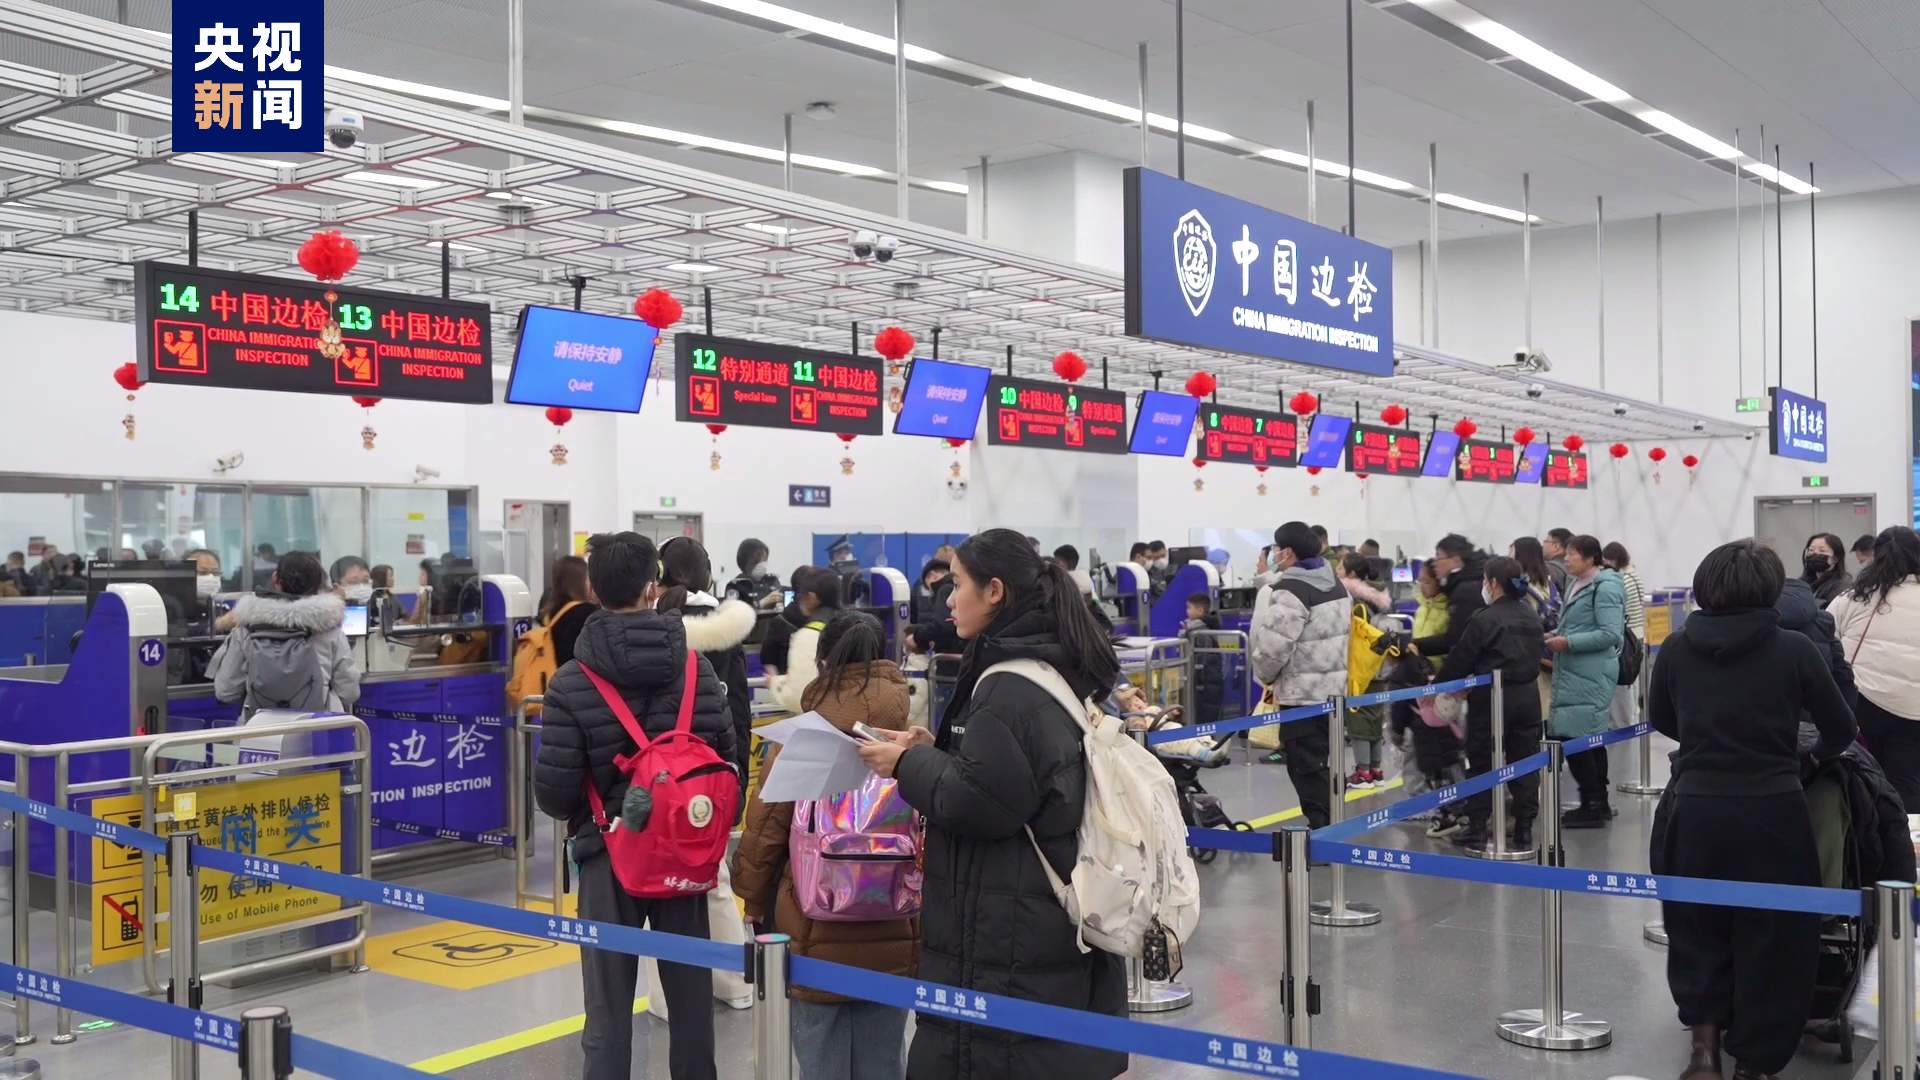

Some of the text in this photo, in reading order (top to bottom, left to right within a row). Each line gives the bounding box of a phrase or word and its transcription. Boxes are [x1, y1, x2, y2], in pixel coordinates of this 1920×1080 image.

[1232, 224, 1377, 322] 中国边检
[160, 283, 200, 312] 14
[211, 290, 328, 331] 中国边检
[339, 304, 373, 331] 13
[208, 328, 321, 350] CHINA IMMIGRATIO
[381, 309, 481, 347] 中国边检
[1233, 306, 1265, 331] CHINA
[1328, 326, 1379, 353] INSPECTION
[235, 348, 309, 366] INSPECTION
[378, 344, 482, 365] CHINA IMMIGRATION
[554, 340, 622, 365] 请保持安静
[693, 348, 717, 371] 12
[402, 363, 464, 380] INSPECTION
[720, 356, 790, 387] 特别通道
[794, 360, 815, 382] 11
[818, 364, 878, 392] 中国边检
[568, 378, 593, 392] Quiet
[1000, 386, 1017, 405] 10
[1256, 418, 1263, 433] 7
[900, 606, 908, 617] 11
[141, 643, 160, 662] 14
[412, 776, 492, 798] INSPECTION
[1352, 848, 1410, 864] 中国边检
[1588, 873, 1657, 889] 中国边检
[200, 896, 319, 925] Use of Mobile Phone
[548, 918, 598, 937] 中国边检
[916, 985, 987, 1011] 中国边检
[1208, 1038, 1300, 1067] 中国边检
